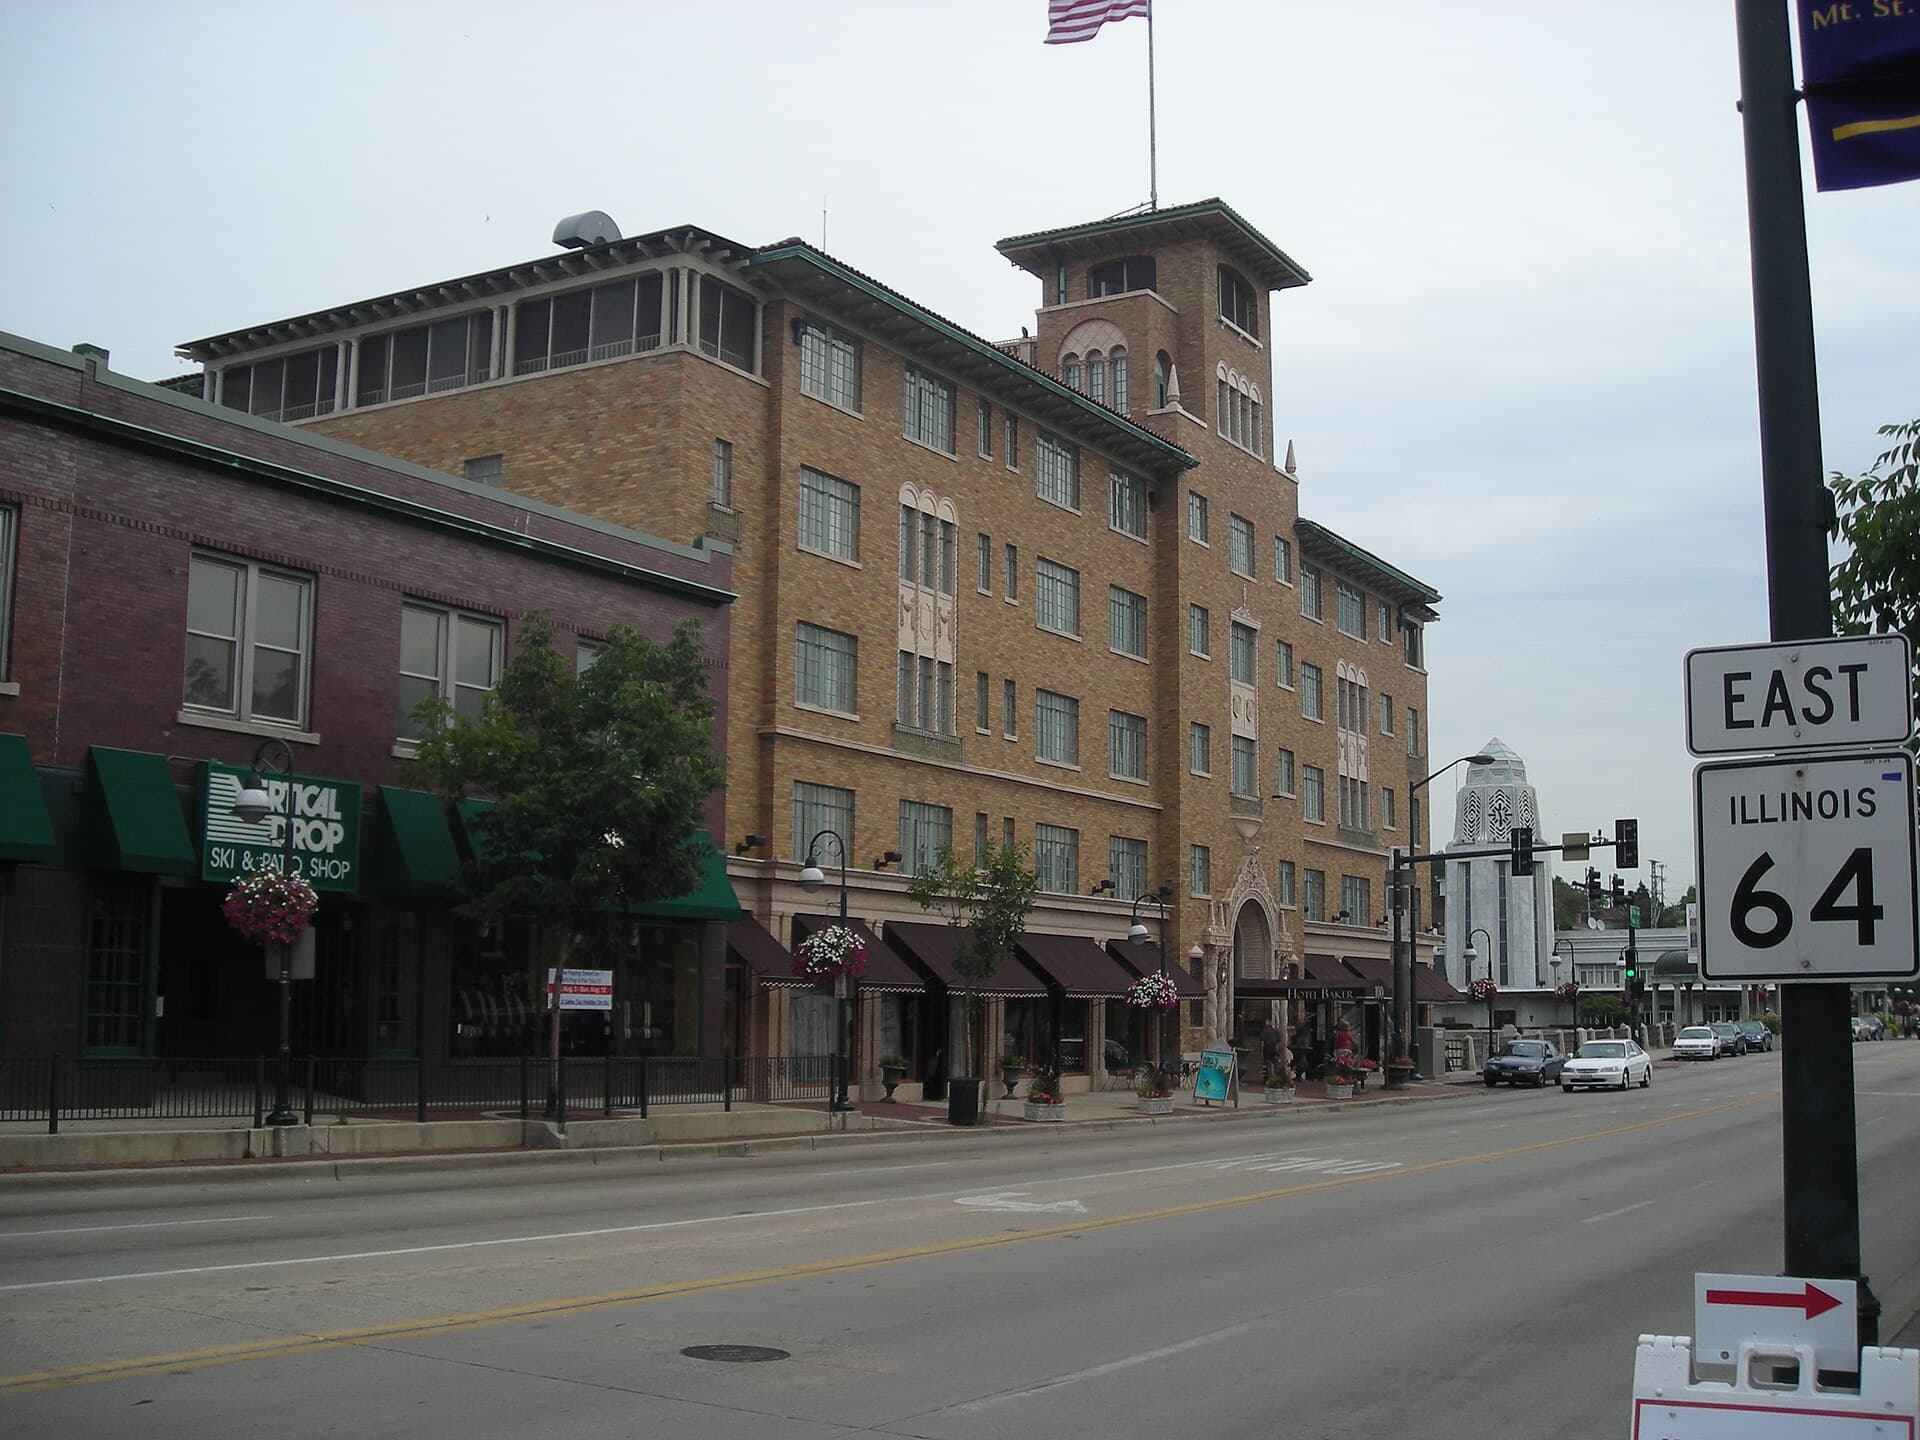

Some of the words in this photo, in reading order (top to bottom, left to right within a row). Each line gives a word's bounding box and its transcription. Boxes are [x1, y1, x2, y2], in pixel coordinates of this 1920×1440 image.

[1812, 3, 1861, 30] Mt.
[1873, 0, 1914, 17] St.
[1724, 664, 1868, 729] EAST
[1730, 788, 1876, 825] ILLINOIS
[210, 847, 235, 869] SKI
[242, 851, 253, 871] &
[310, 858, 350, 880] SHOP
[1730, 847, 1884, 949] 64
[1321, 987, 1354, 1000] BAKER
